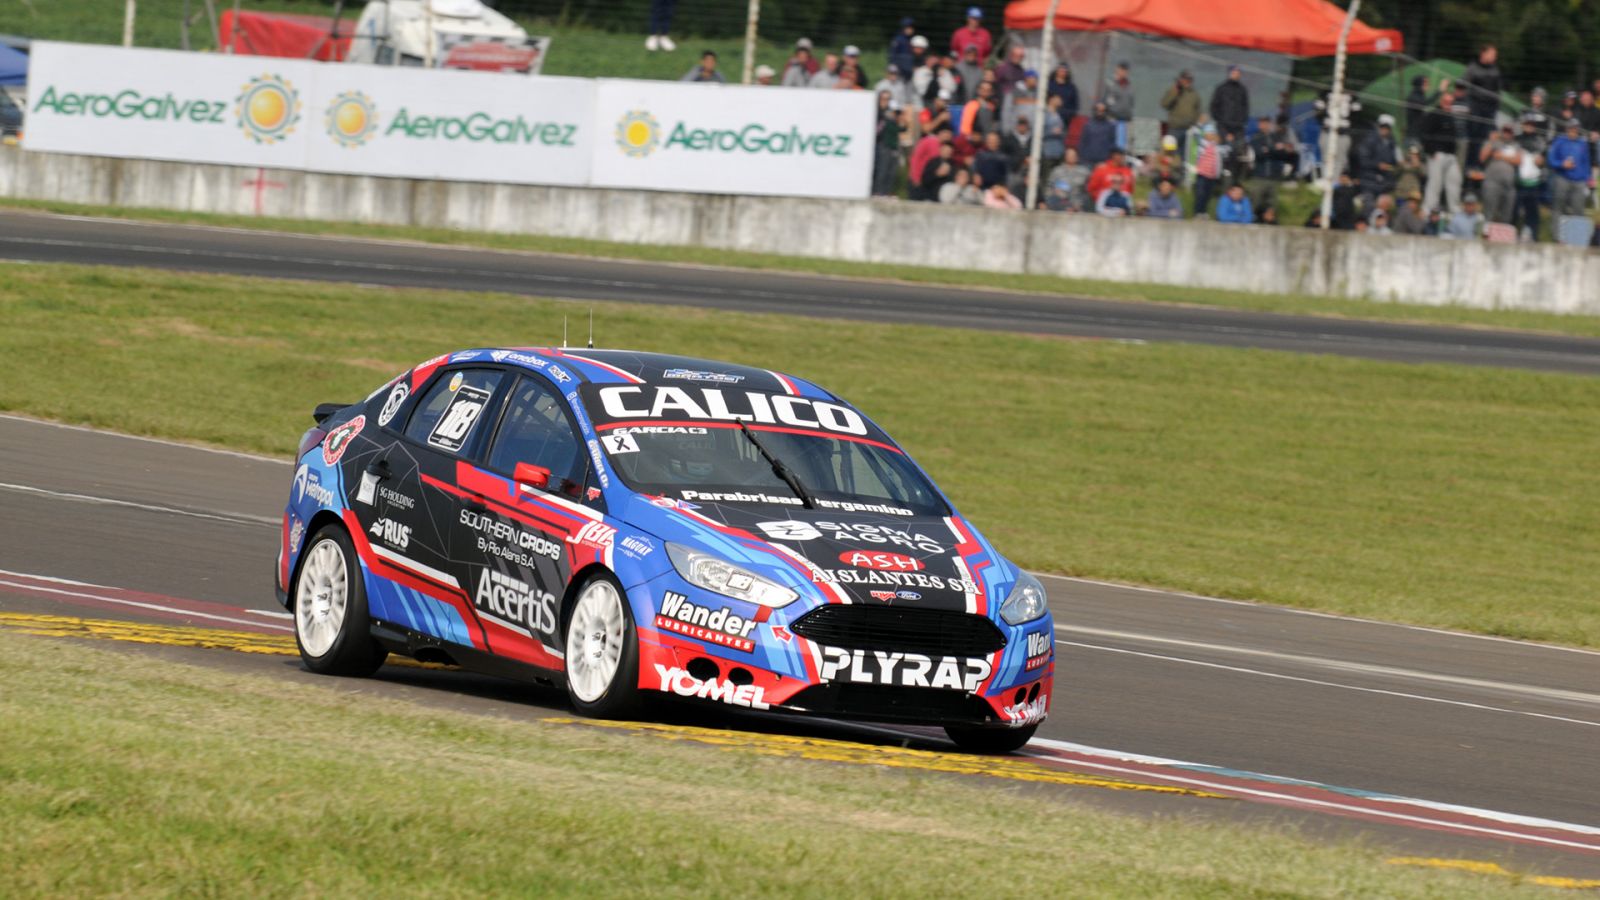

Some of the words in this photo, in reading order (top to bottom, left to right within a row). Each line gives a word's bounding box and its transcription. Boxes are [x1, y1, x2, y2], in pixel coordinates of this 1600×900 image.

[33, 84, 227, 123] AeroGalvez
[385, 107, 577, 147] AeroGalvez
[665, 121, 853, 157] AeroGalvez
[599, 386, 867, 435] CALICO
[613, 426, 688, 436] GARCIA
[387, 489, 415, 509] HOLDING
[681, 490, 804, 505] Parabrisas
[384, 517, 409, 548] RUS
[460, 509, 519, 544] SOUTHERN
[519, 531, 560, 560] CROPS
[477, 536, 489, 553] By
[815, 521, 940, 545] SIGMA
[835, 531, 945, 554] AGRO
[851, 552, 918, 571] ASH
[812, 569, 945, 590] AISLANTES
[660, 591, 757, 638] Wander
[657, 617, 751, 650] LUBRICANTES
[821, 646, 992, 690] PLYRAP
[654, 663, 770, 710] YOMEL
